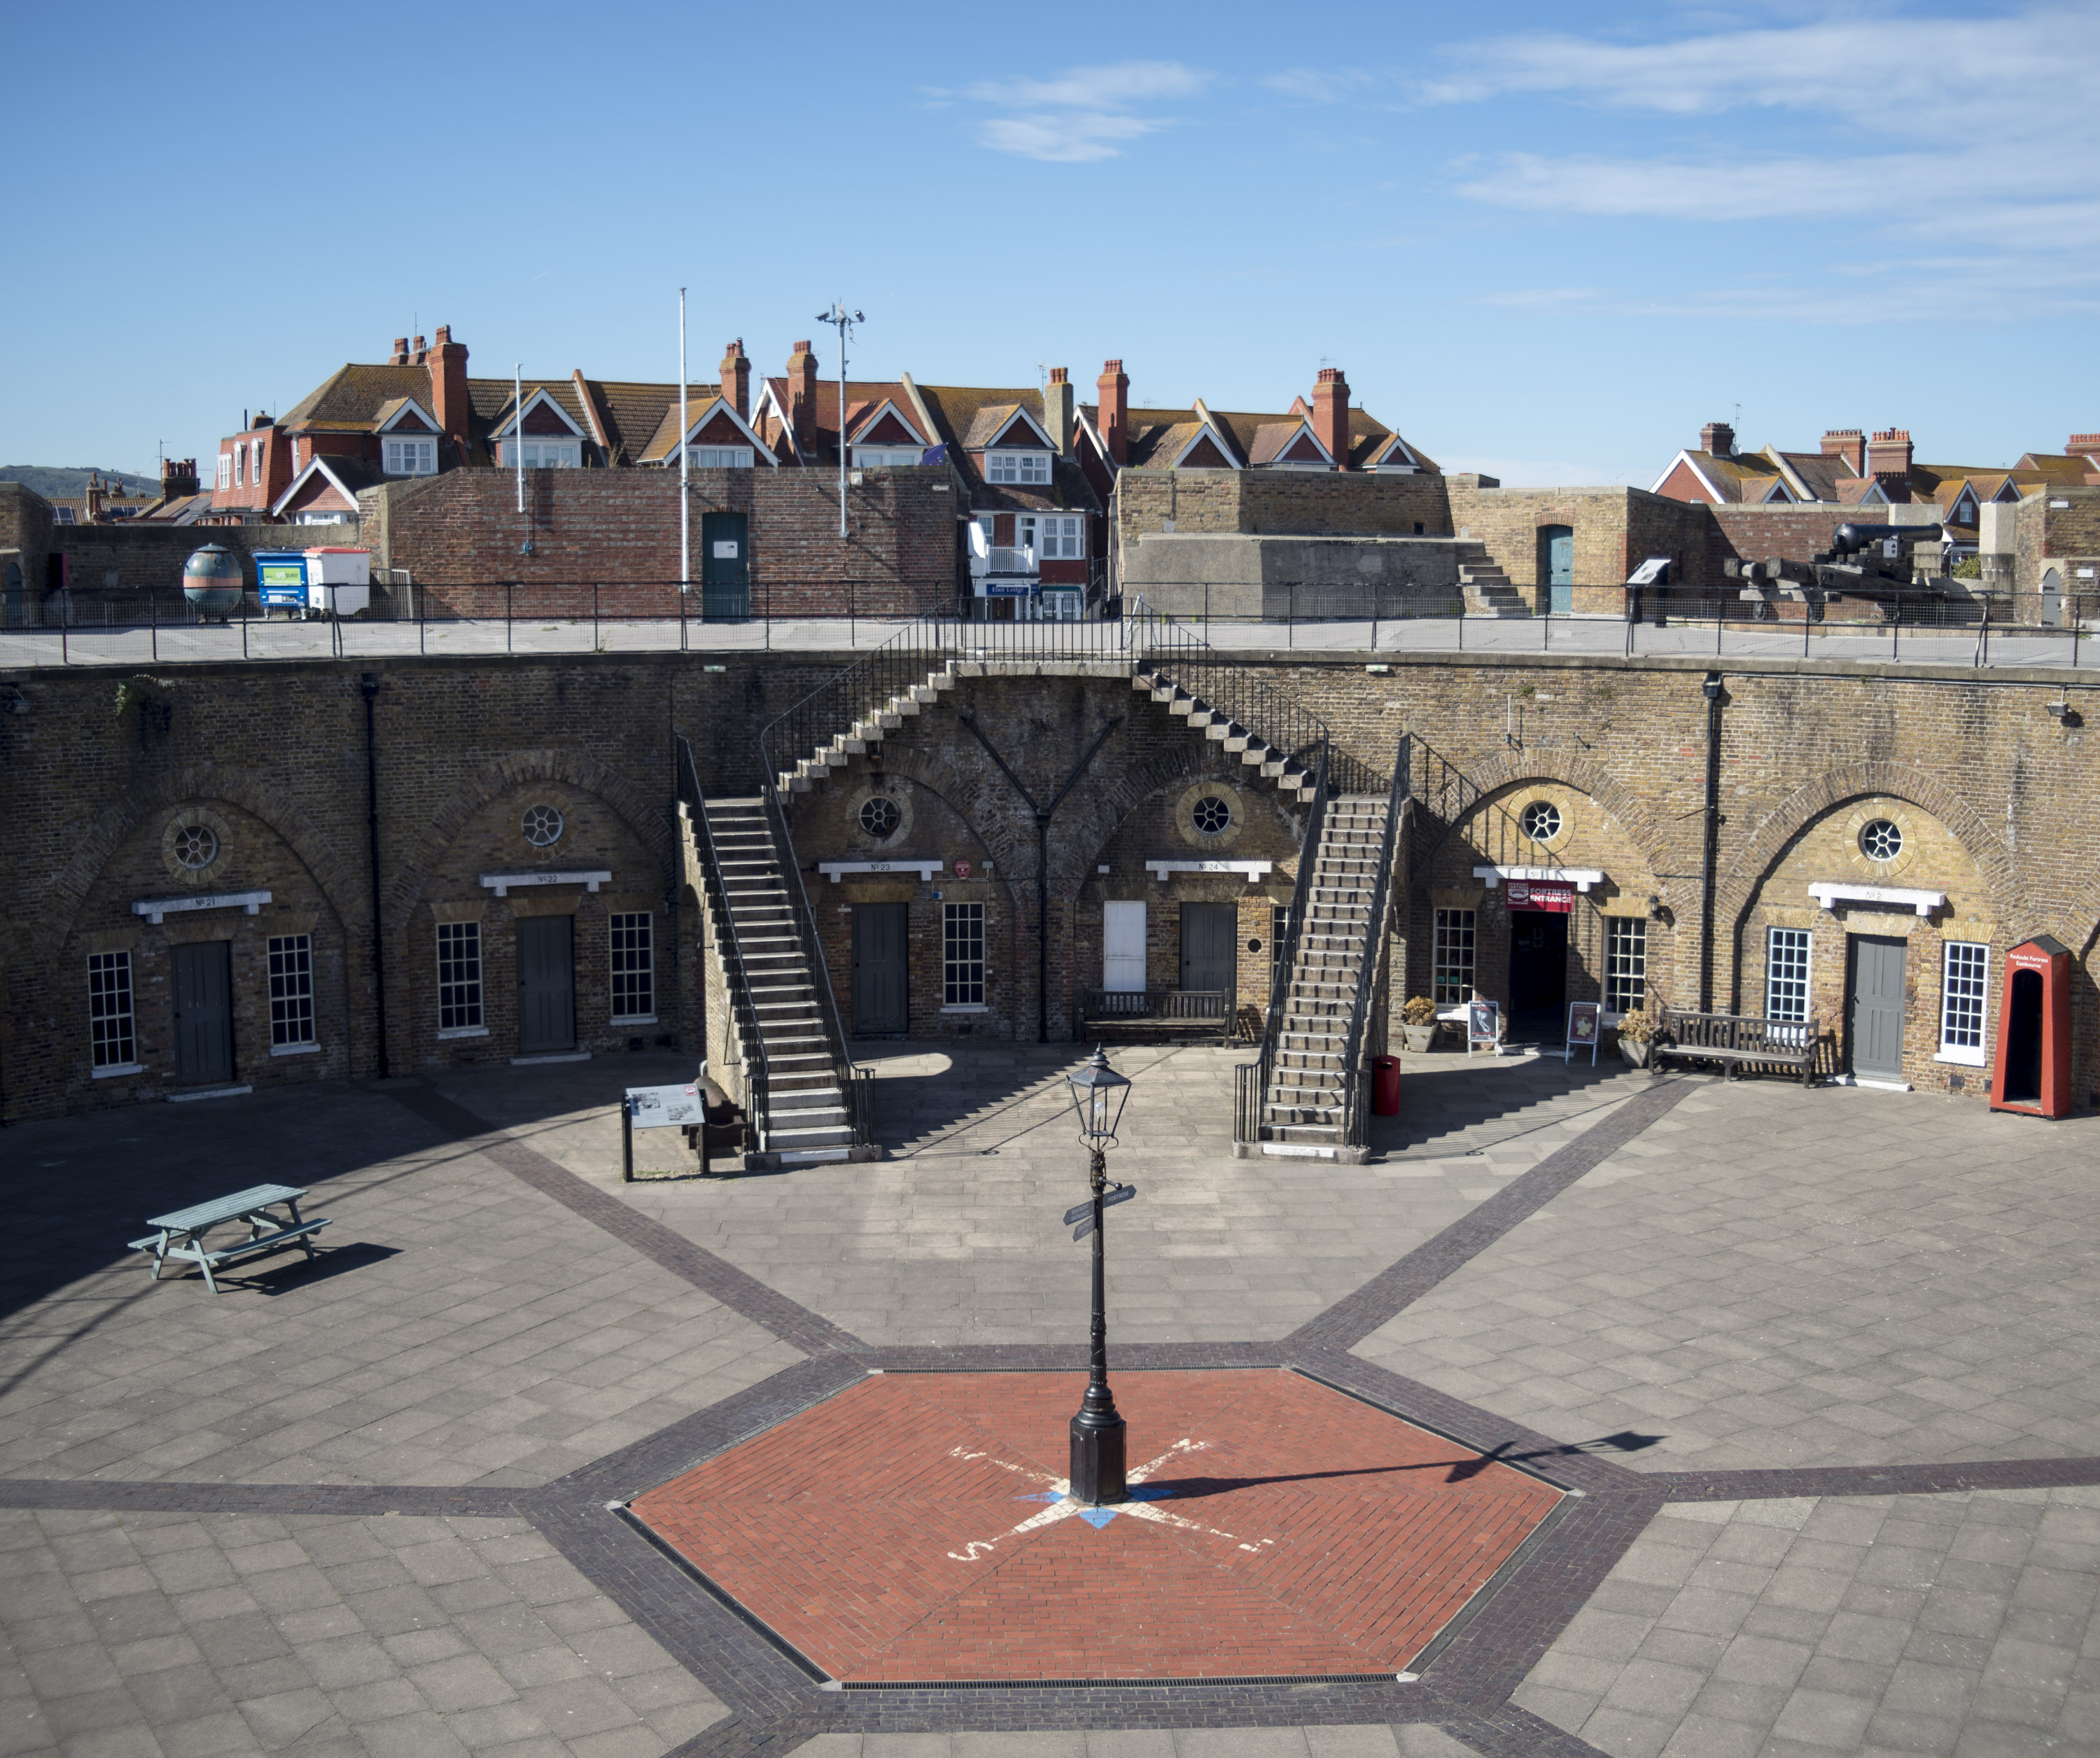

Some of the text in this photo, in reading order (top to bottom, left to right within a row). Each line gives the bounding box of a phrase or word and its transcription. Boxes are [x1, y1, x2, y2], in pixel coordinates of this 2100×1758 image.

[1530, 888, 1572, 896] FORTRESS
[206, 898, 216, 907] 21
[1530, 895, 1572, 903] ENTRANCE
[1107, 1191, 1129, 1202] FORTRESS
[1070, 1210, 1089, 1222] ENTRANCE
[947, 1541, 994, 1561] S
